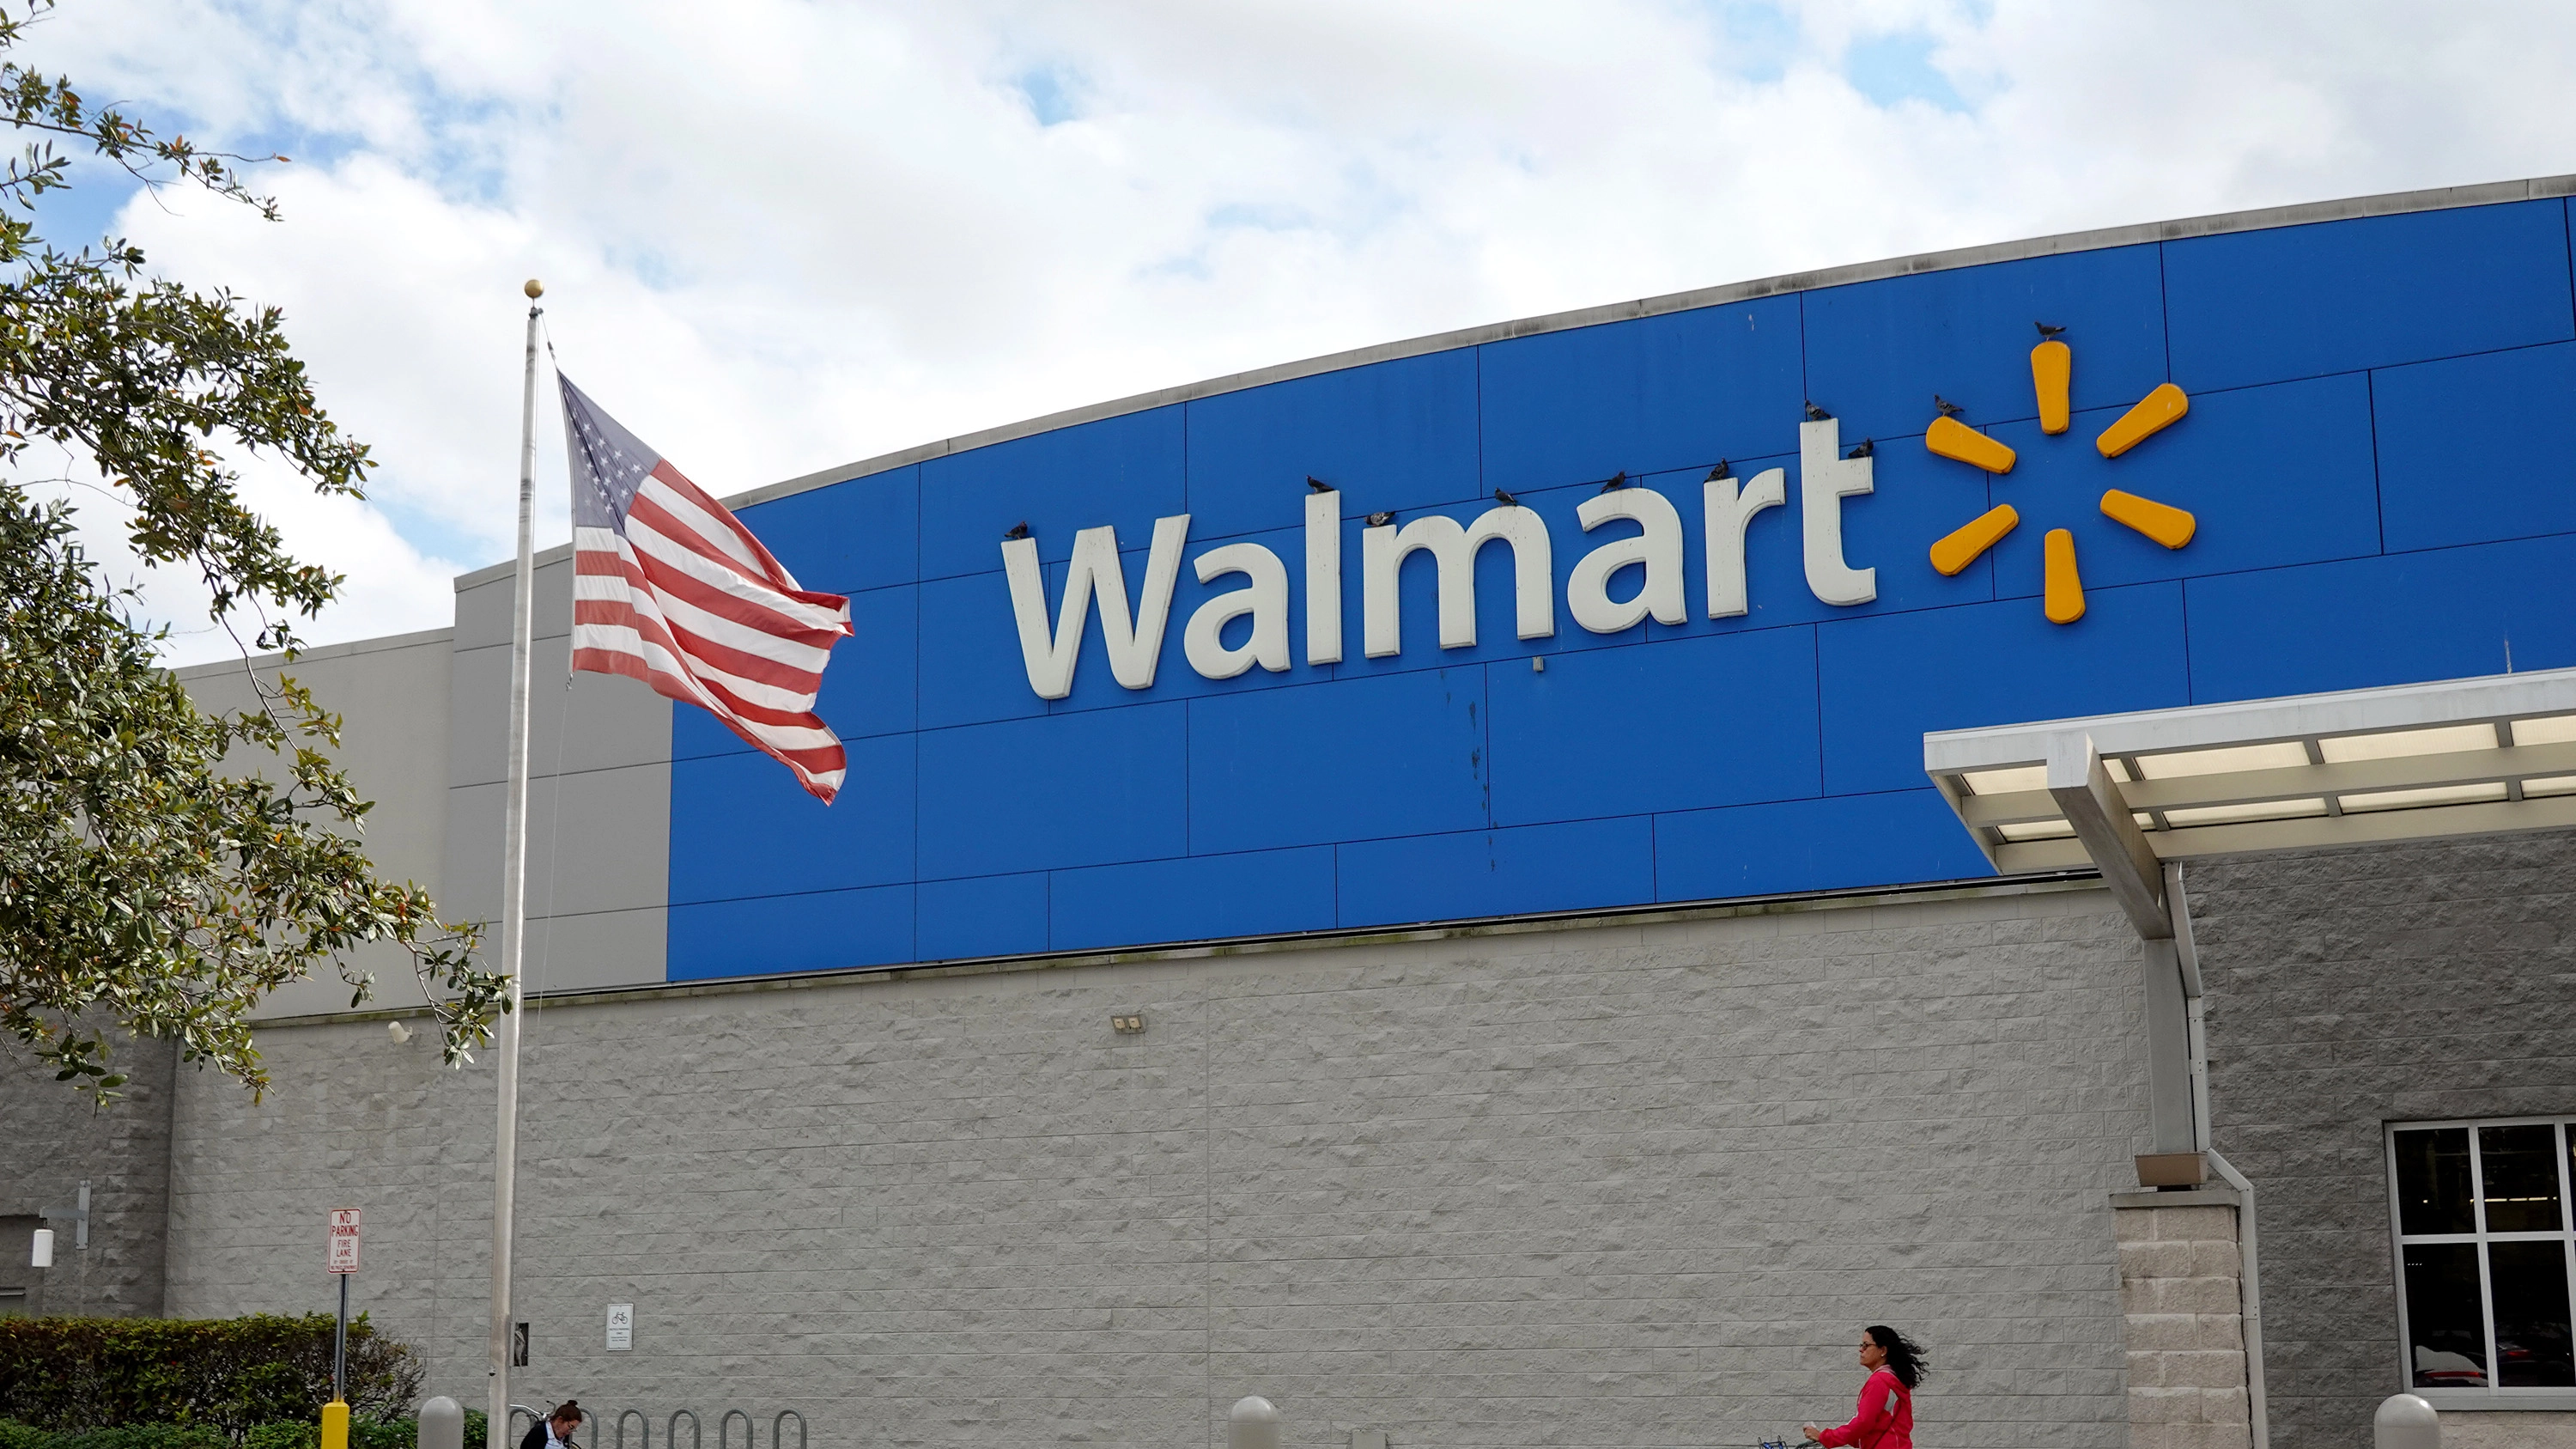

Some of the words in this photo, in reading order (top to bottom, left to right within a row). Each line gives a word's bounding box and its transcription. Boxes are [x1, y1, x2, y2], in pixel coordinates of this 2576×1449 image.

[1001, 418, 1877, 699] Walmart
[339, 1212, 351, 1224] NO
[331, 1225, 359, 1237] PARKING
[337, 1239, 351, 1248] FIRE
[337, 1249, 351, 1257] LANE
